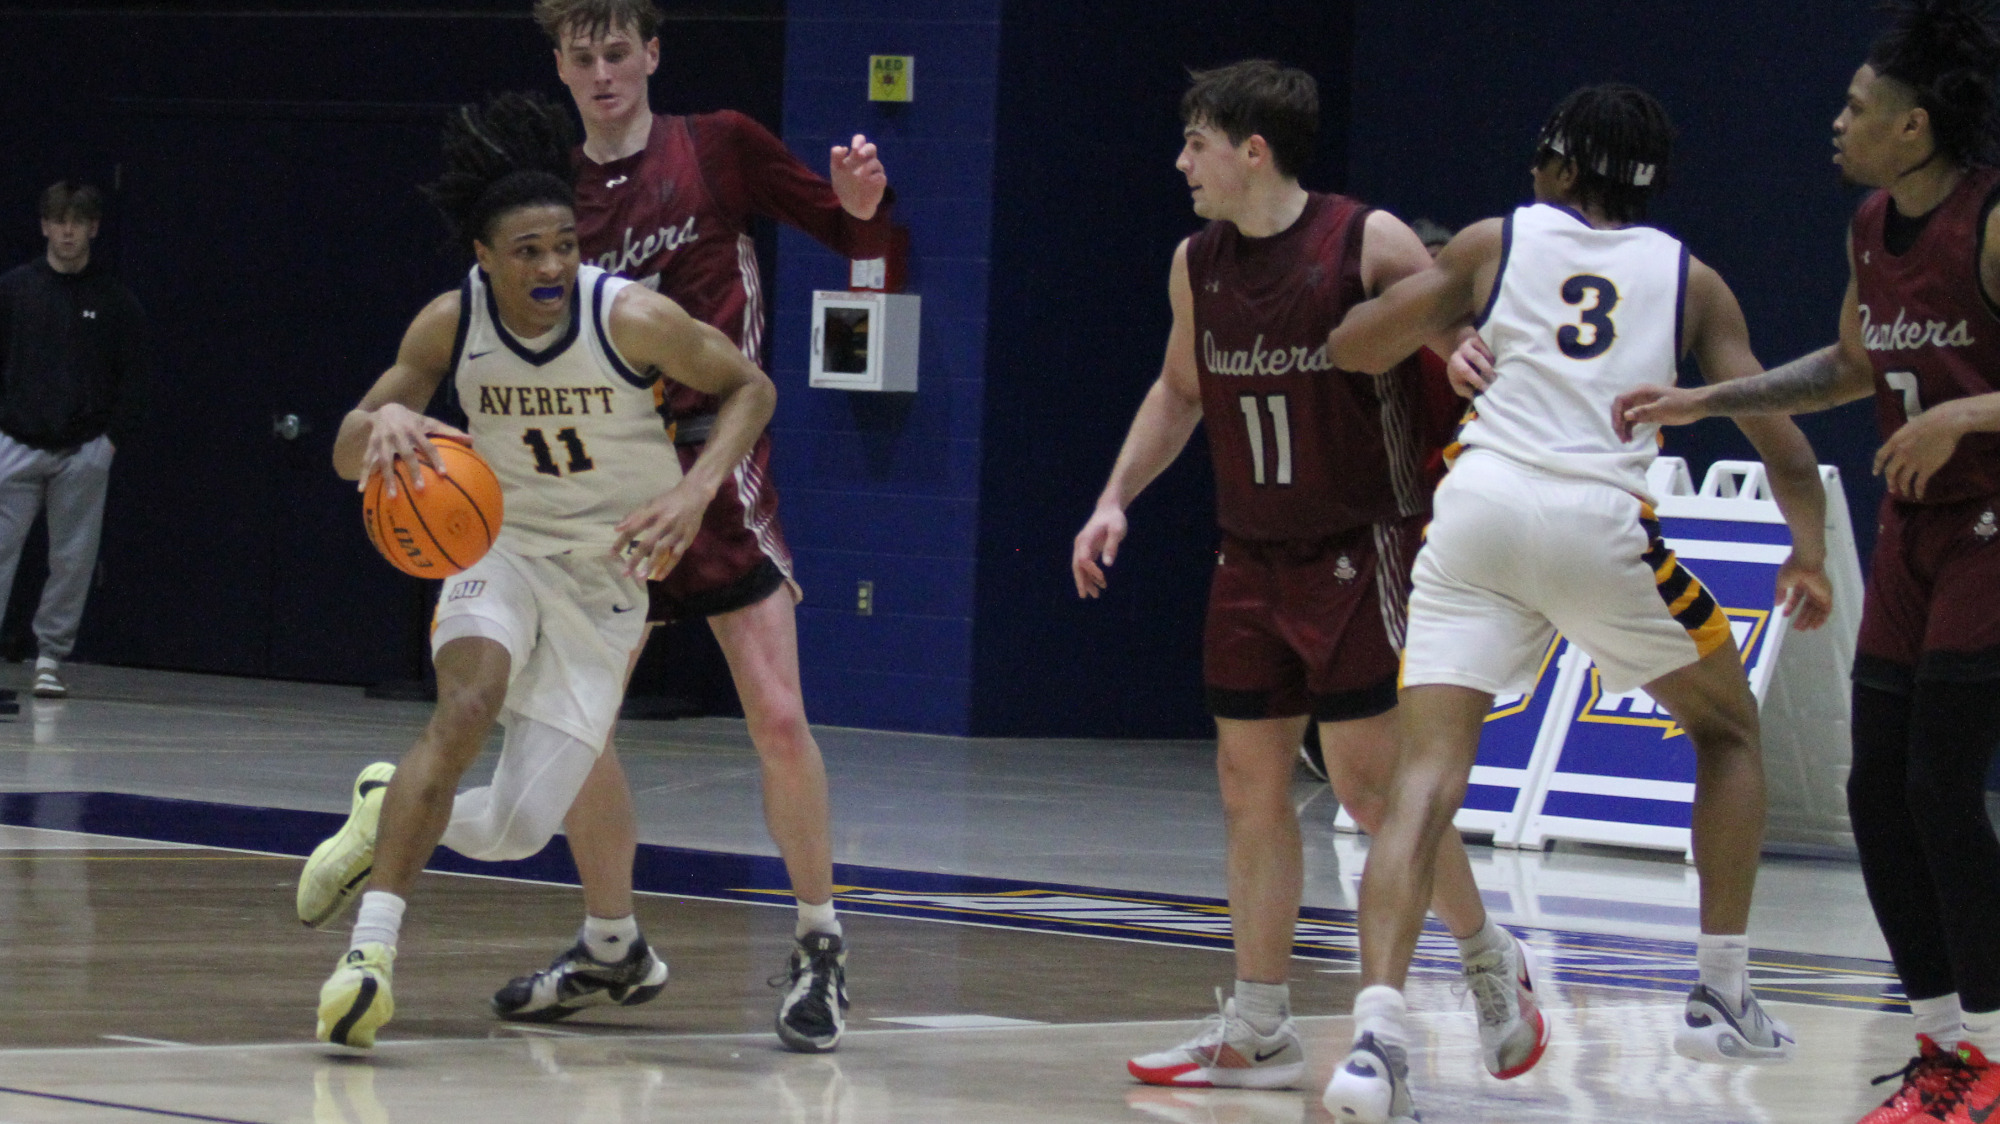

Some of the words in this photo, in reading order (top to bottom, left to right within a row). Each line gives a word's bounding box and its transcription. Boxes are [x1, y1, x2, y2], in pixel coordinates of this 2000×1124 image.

[875, 59, 903, 71] AED
[588, 216, 699, 276] akers
[1556, 272, 1624, 361] 3
[1203, 330, 1334, 376] Quakers
[479, 385, 614, 416] AVERETT
[522, 426, 595, 477] 11
[1239, 395, 1292, 484] 11
[448, 580, 487, 601] AU
